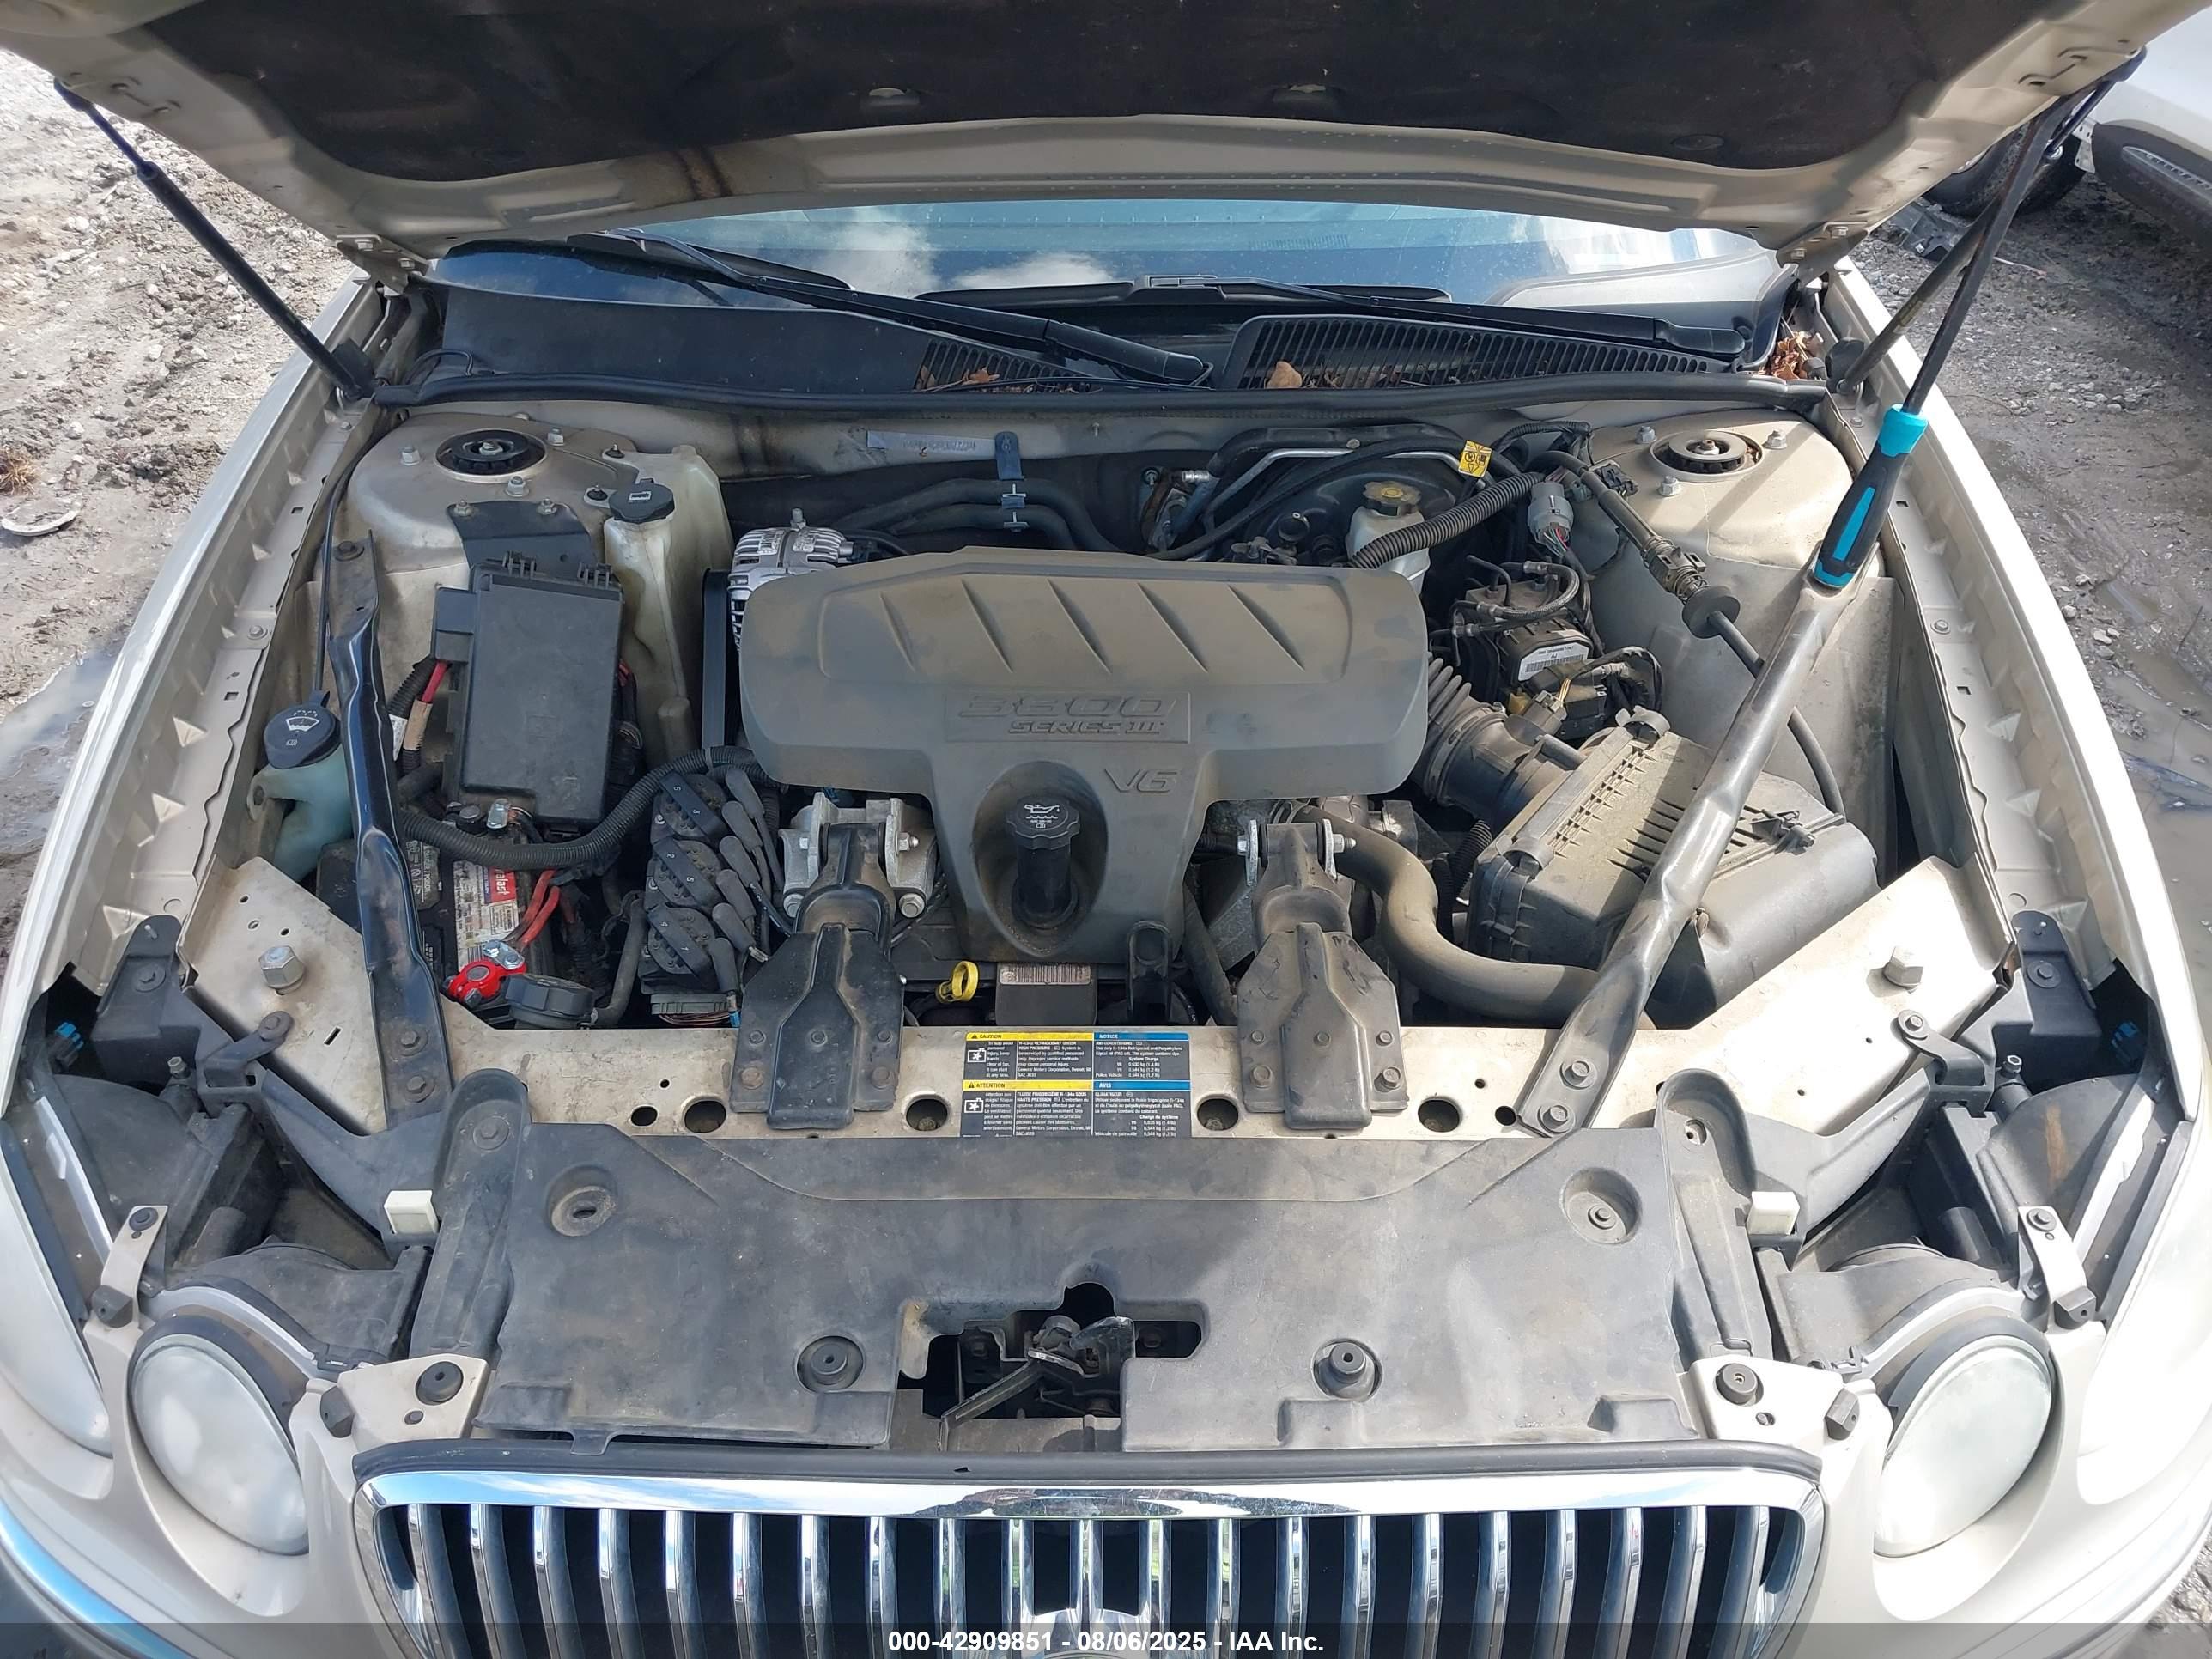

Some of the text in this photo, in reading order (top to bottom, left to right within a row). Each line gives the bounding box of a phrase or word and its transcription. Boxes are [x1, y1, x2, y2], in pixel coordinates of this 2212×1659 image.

[1008, 720, 1122, 735] SERIES
[1103, 768, 1179, 793] V6
[495, 867, 510, 895] ralast
